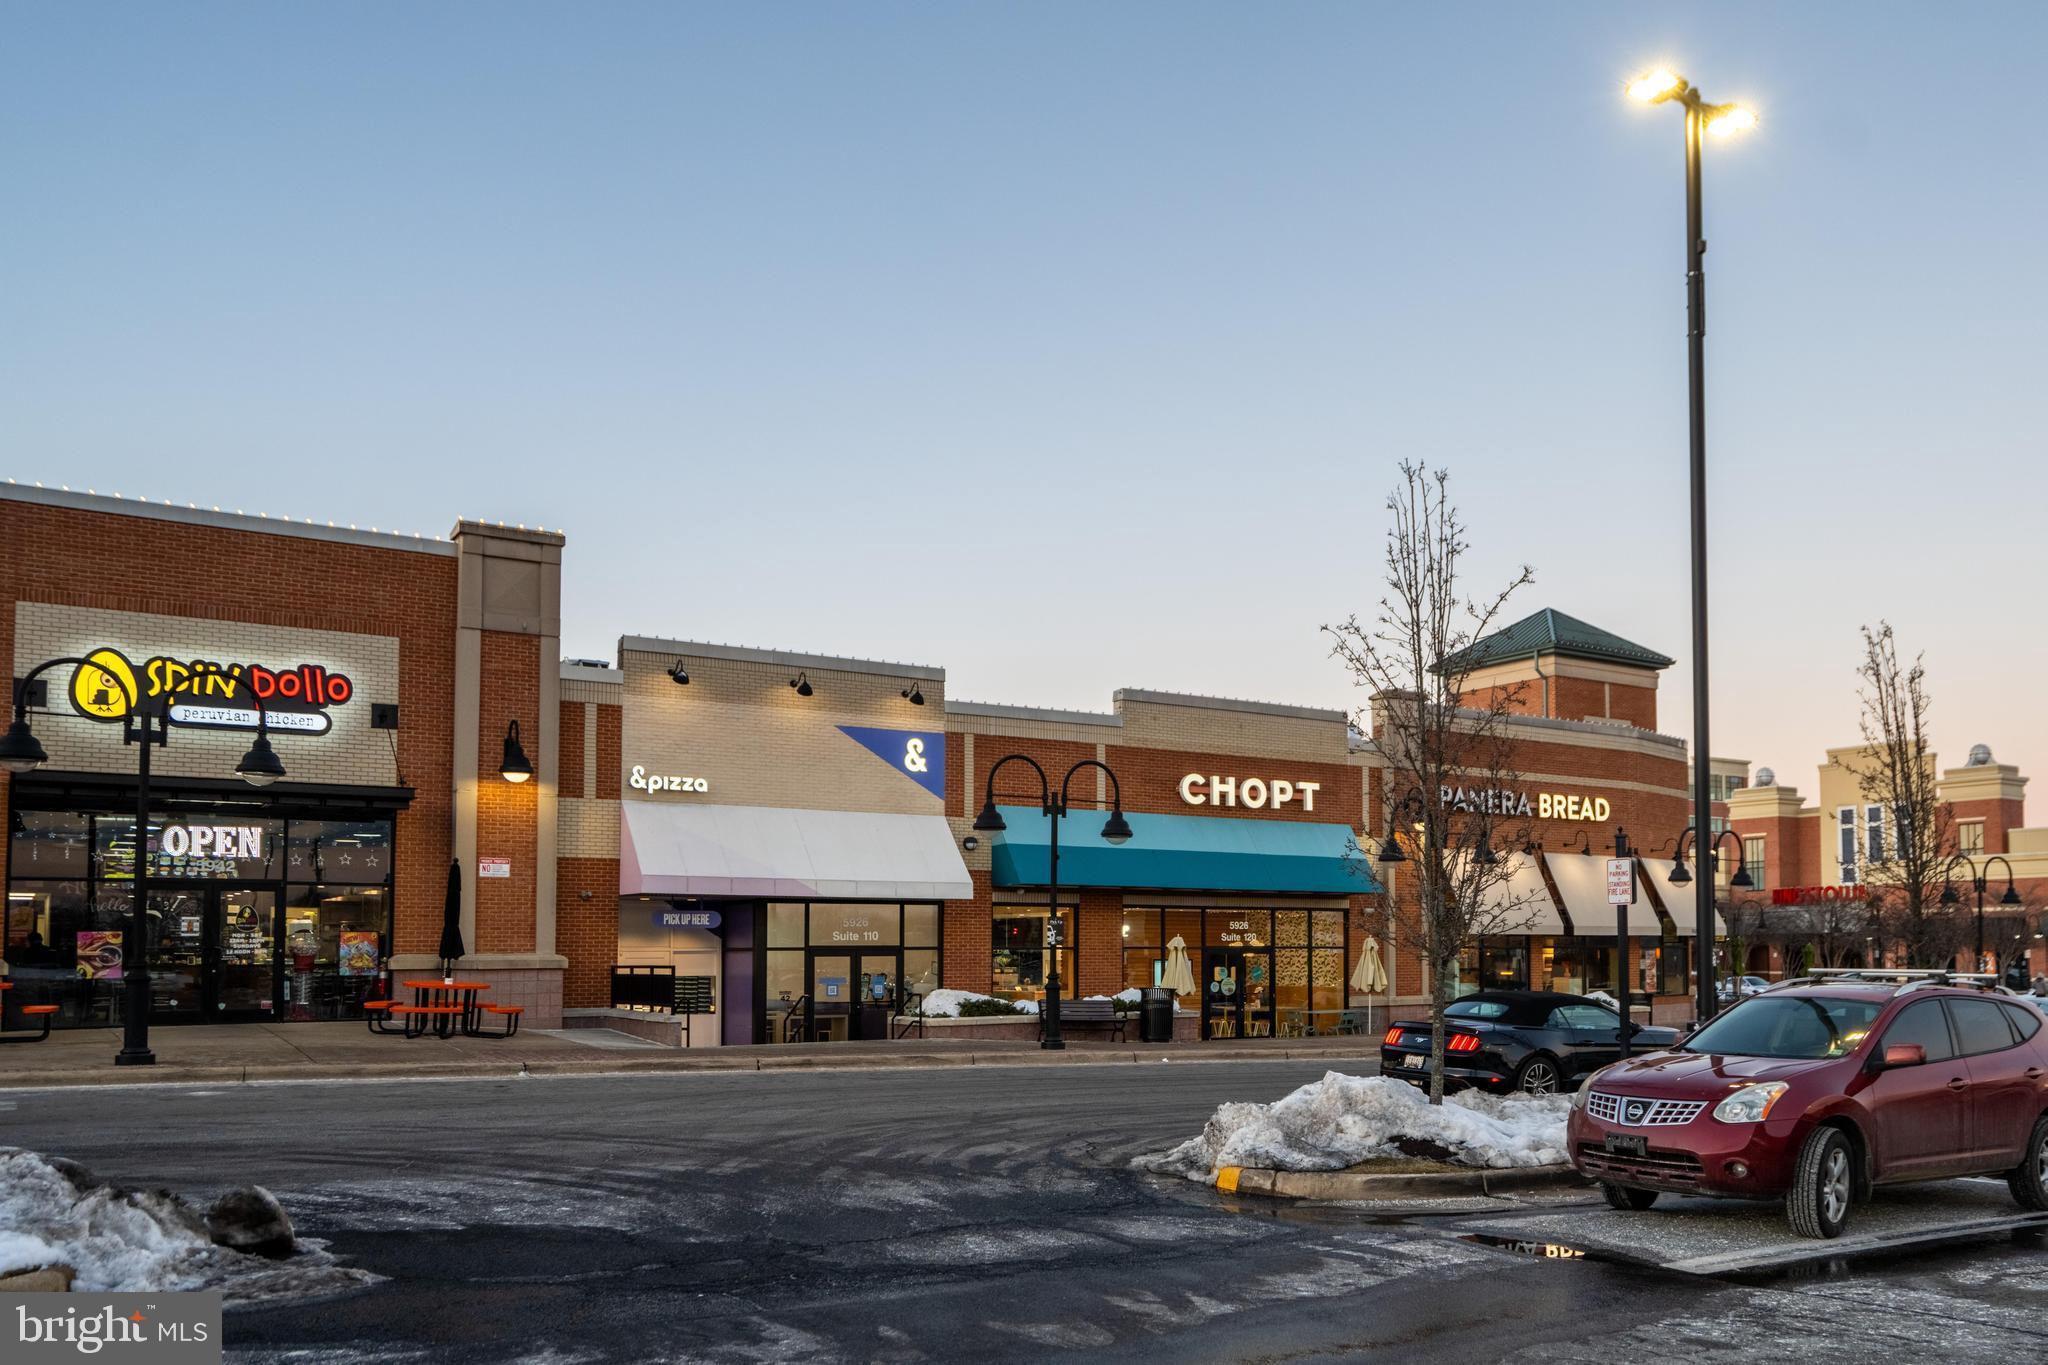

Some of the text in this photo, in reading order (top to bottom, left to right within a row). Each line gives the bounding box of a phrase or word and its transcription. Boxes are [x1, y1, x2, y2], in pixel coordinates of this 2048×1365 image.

[183, 707, 314, 727] peruvian hicken
[904, 738, 928, 772] &
[630, 765, 708, 794] &pizza
[1179, 773, 1320, 811] CHOPT
[1440, 784, 1611, 822] PANERA BREAD
[163, 825, 262, 858] OPEN
[481, 864, 491, 873] NO
[663, 913, 710, 925] PICK UP HERE
[843, 919, 869, 928] 5926
[1229, 921, 1249, 930] 5926
[832, 931, 879, 941] Suite 110
[1221, 932, 1257, 942] Suite 120
